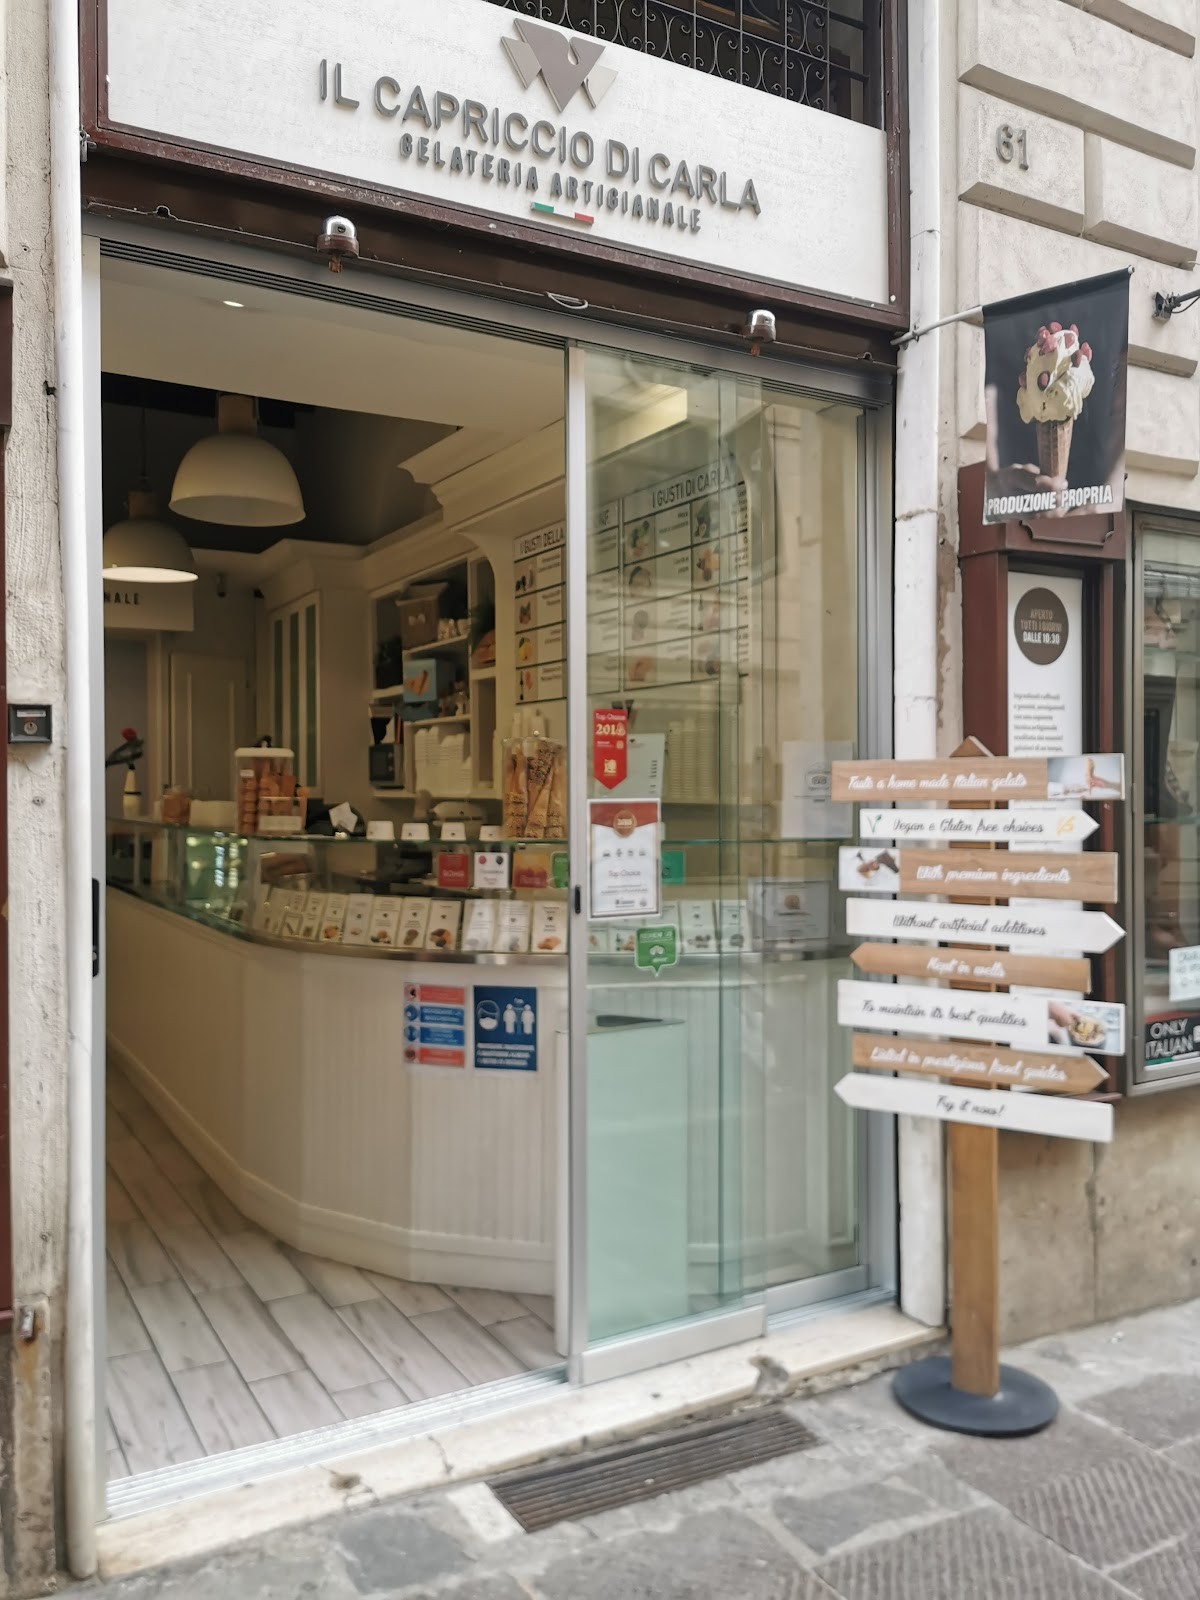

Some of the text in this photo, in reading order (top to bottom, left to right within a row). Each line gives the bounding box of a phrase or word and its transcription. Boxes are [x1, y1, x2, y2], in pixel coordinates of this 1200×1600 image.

[319, 58, 762, 216] IL CAPRICCIO DI CARLA
[995, 123, 1030, 171] 61
[400, 132, 702, 232] GELATERIA ARTIGIANALE
[987, 484, 1113, 516] PRODUZIONE PROPRIA
[1023, 630, 1061, 646] DALLE 10:30
[876, 780, 885, 789] a
[886, 774, 917, 789] home
[918, 773, 950, 789] made
[952, 772, 988, 789] Italian
[990, 771, 1027, 793] gelato
[893, 817, 926, 834] Vegan
[939, 815, 974, 832] Gluten
[975, 816, 999, 835] free
[1002, 818, 1044, 833] choices
[916, 864, 1071, 886] With premium ingredients
[893, 914, 1048, 936] Without artificial additives
[878, 1004, 926, 1017] maintain
[949, 1007, 976, 1022] best
[976, 1010, 1027, 1028] qualities
[1150, 1018, 1188, 1040] ONLY
[1145, 1033, 1194, 1060] ITALIAN
[988, 1056, 1024, 1077] food
[1022, 1063, 1068, 1083] guides
